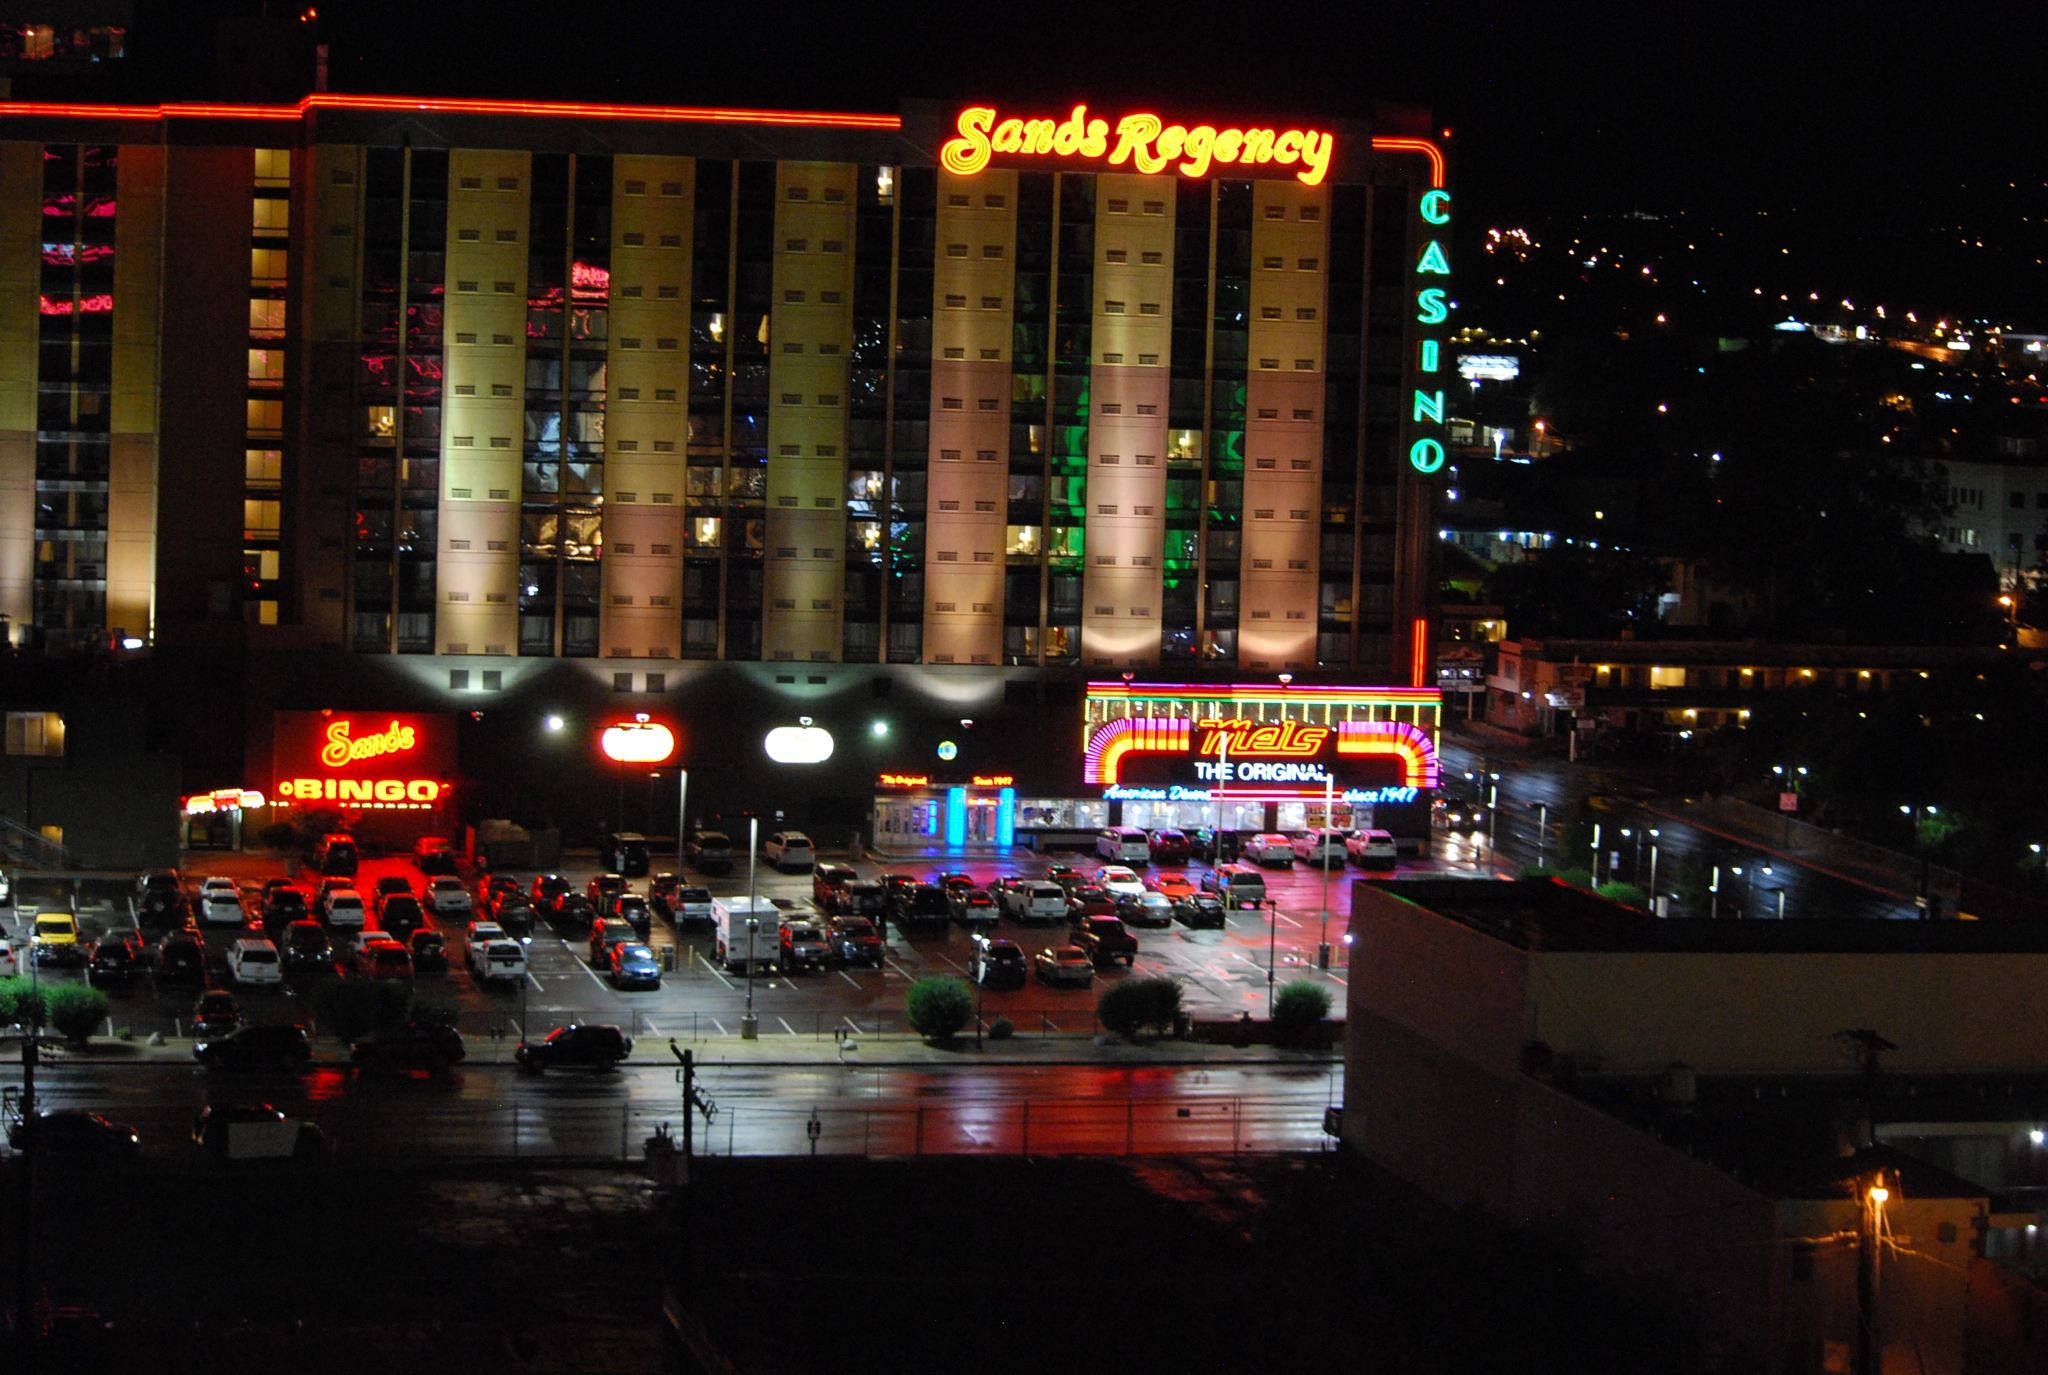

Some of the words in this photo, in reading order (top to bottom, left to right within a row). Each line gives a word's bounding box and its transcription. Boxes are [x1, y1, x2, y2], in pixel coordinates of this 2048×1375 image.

[940, 105, 1110, 175] Sands
[1108, 113, 1333, 186] Regency
[1410, 189, 1450, 473] CASINO
[321, 720, 416, 767] Sands
[1194, 762, 1234, 780] THE
[1237, 762, 1330, 781] ORIGINAL
[293, 778, 439, 801] BINGO
[1102, 783, 1167, 800] American
[1379, 786, 1418, 803] 1947
